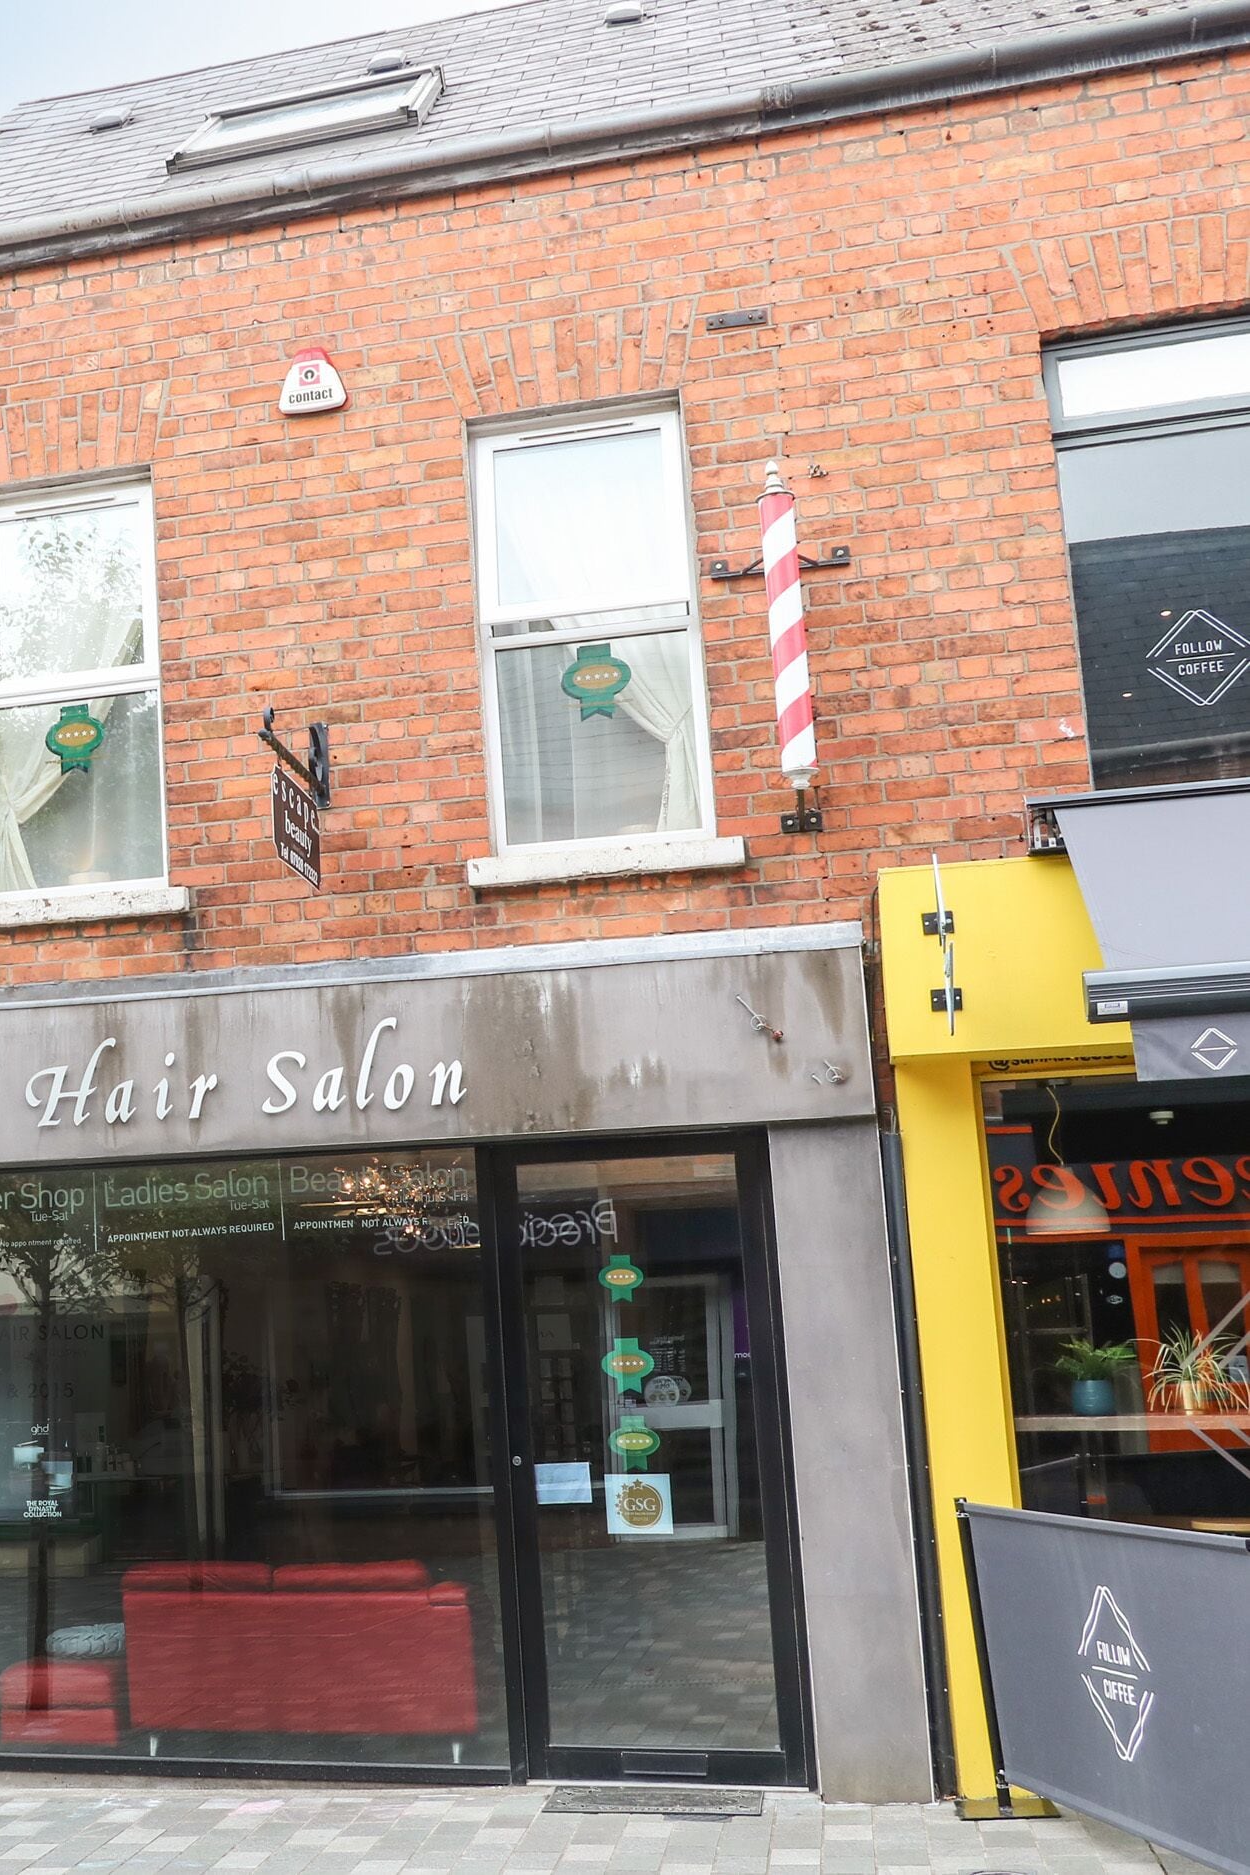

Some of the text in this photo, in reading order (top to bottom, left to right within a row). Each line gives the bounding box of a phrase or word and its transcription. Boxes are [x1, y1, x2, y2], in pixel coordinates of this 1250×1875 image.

[289, 388, 333, 404] contact
[1175, 639, 1223, 655] FOLLOW
[1178, 661, 1225, 676] COFFEE
[273, 773, 316, 830] escape
[285, 810, 313, 858] beauty
[280, 842, 289, 860] Tel
[25, 1037, 219, 1129] Hair
[261, 1017, 467, 1116] Salon
[104, 1168, 269, 1208] Ladies Salon
[20, 1182, 85, 1214] Shop
[230, 1199, 270, 1211] Tue-Sat
[30, 1209, 69, 1222] Tue-Sat
[294, 1219, 354, 1230] APPOINTMEN
[361, 1218, 380, 1228] NOT
[382, 1216, 420, 1227] ALWAYS
[107, 1222, 275, 1243] APPOINTMENT NOT ALWAYS REQUIRED
[11, 1239, 52, 1248] appontment
[38, 1324, 104, 1341] SALON
[30, 1423, 50, 1436] ghd
[623, 1497, 657, 1512] GSG
[1096, 1640, 1131, 1667] FOLLOW
[1103, 1678, 1138, 1706] COFFEE
